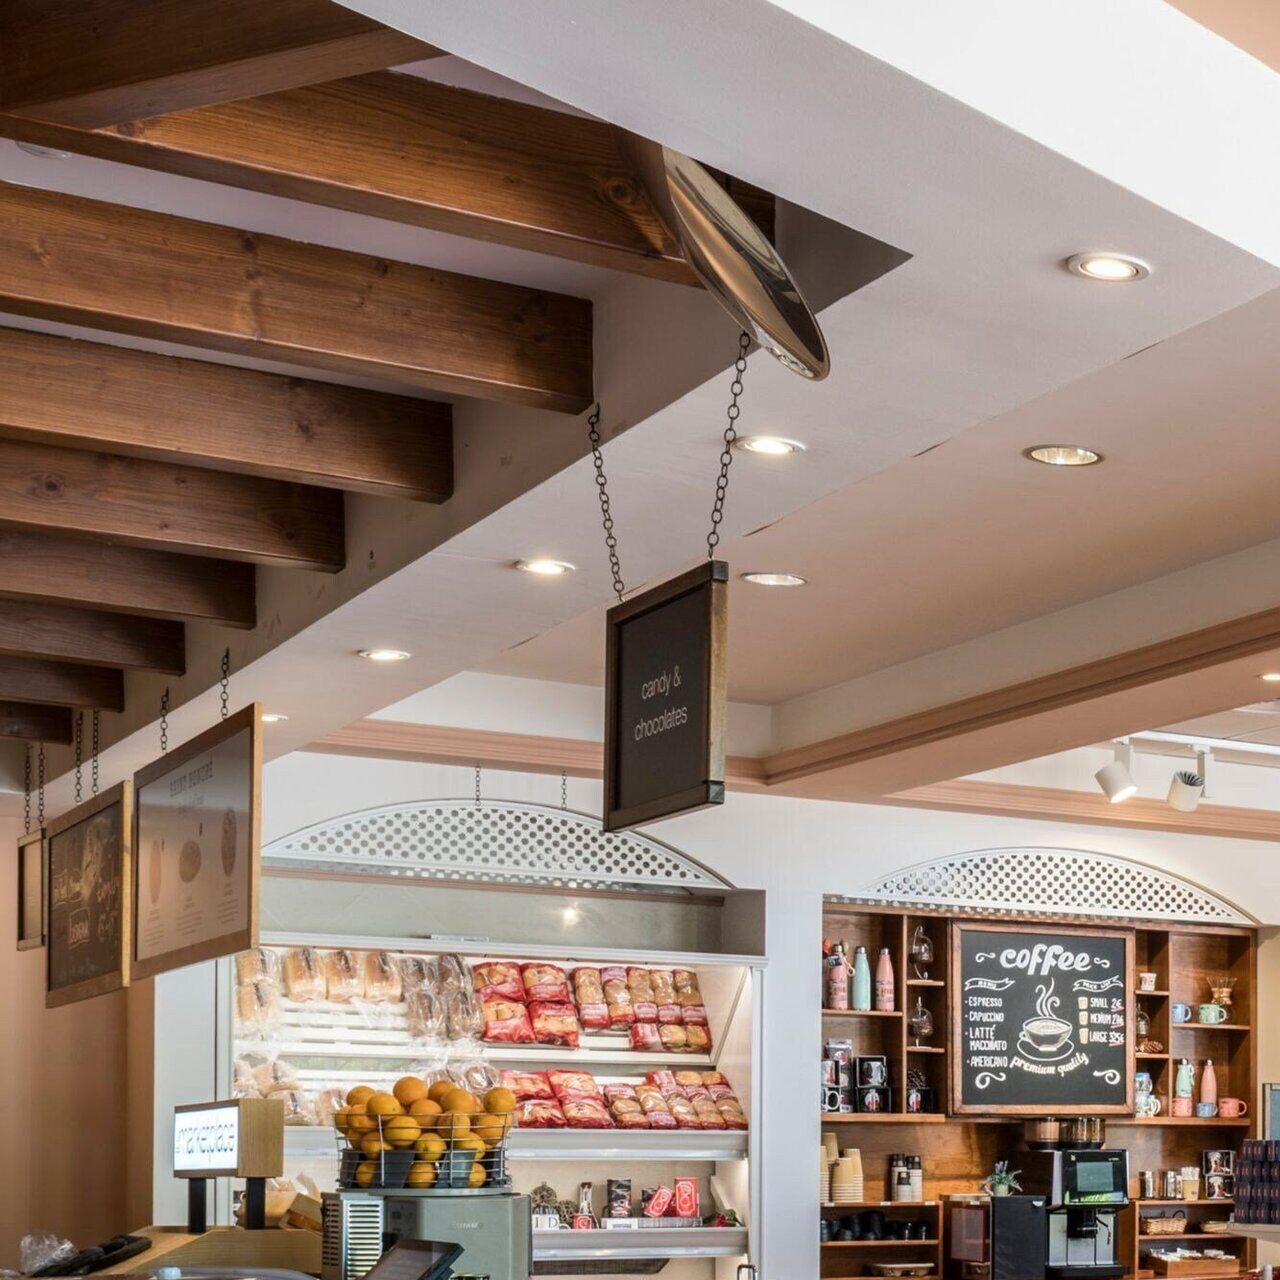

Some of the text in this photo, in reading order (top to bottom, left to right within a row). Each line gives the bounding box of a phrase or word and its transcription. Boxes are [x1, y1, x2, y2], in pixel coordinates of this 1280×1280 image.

[641, 664, 681, 700] candy &
[635, 706, 688, 741] chocolates
[1000, 943, 1091, 975] coffee
[968, 996, 1003, 1007] ESPRESSO
[1090, 997, 1108, 1008] SMALL
[1089, 1031, 1108, 1042] LARGE
[970, 1056, 1009, 1067] AMERICANO
[1009, 1052, 1090, 1078] premium quality
